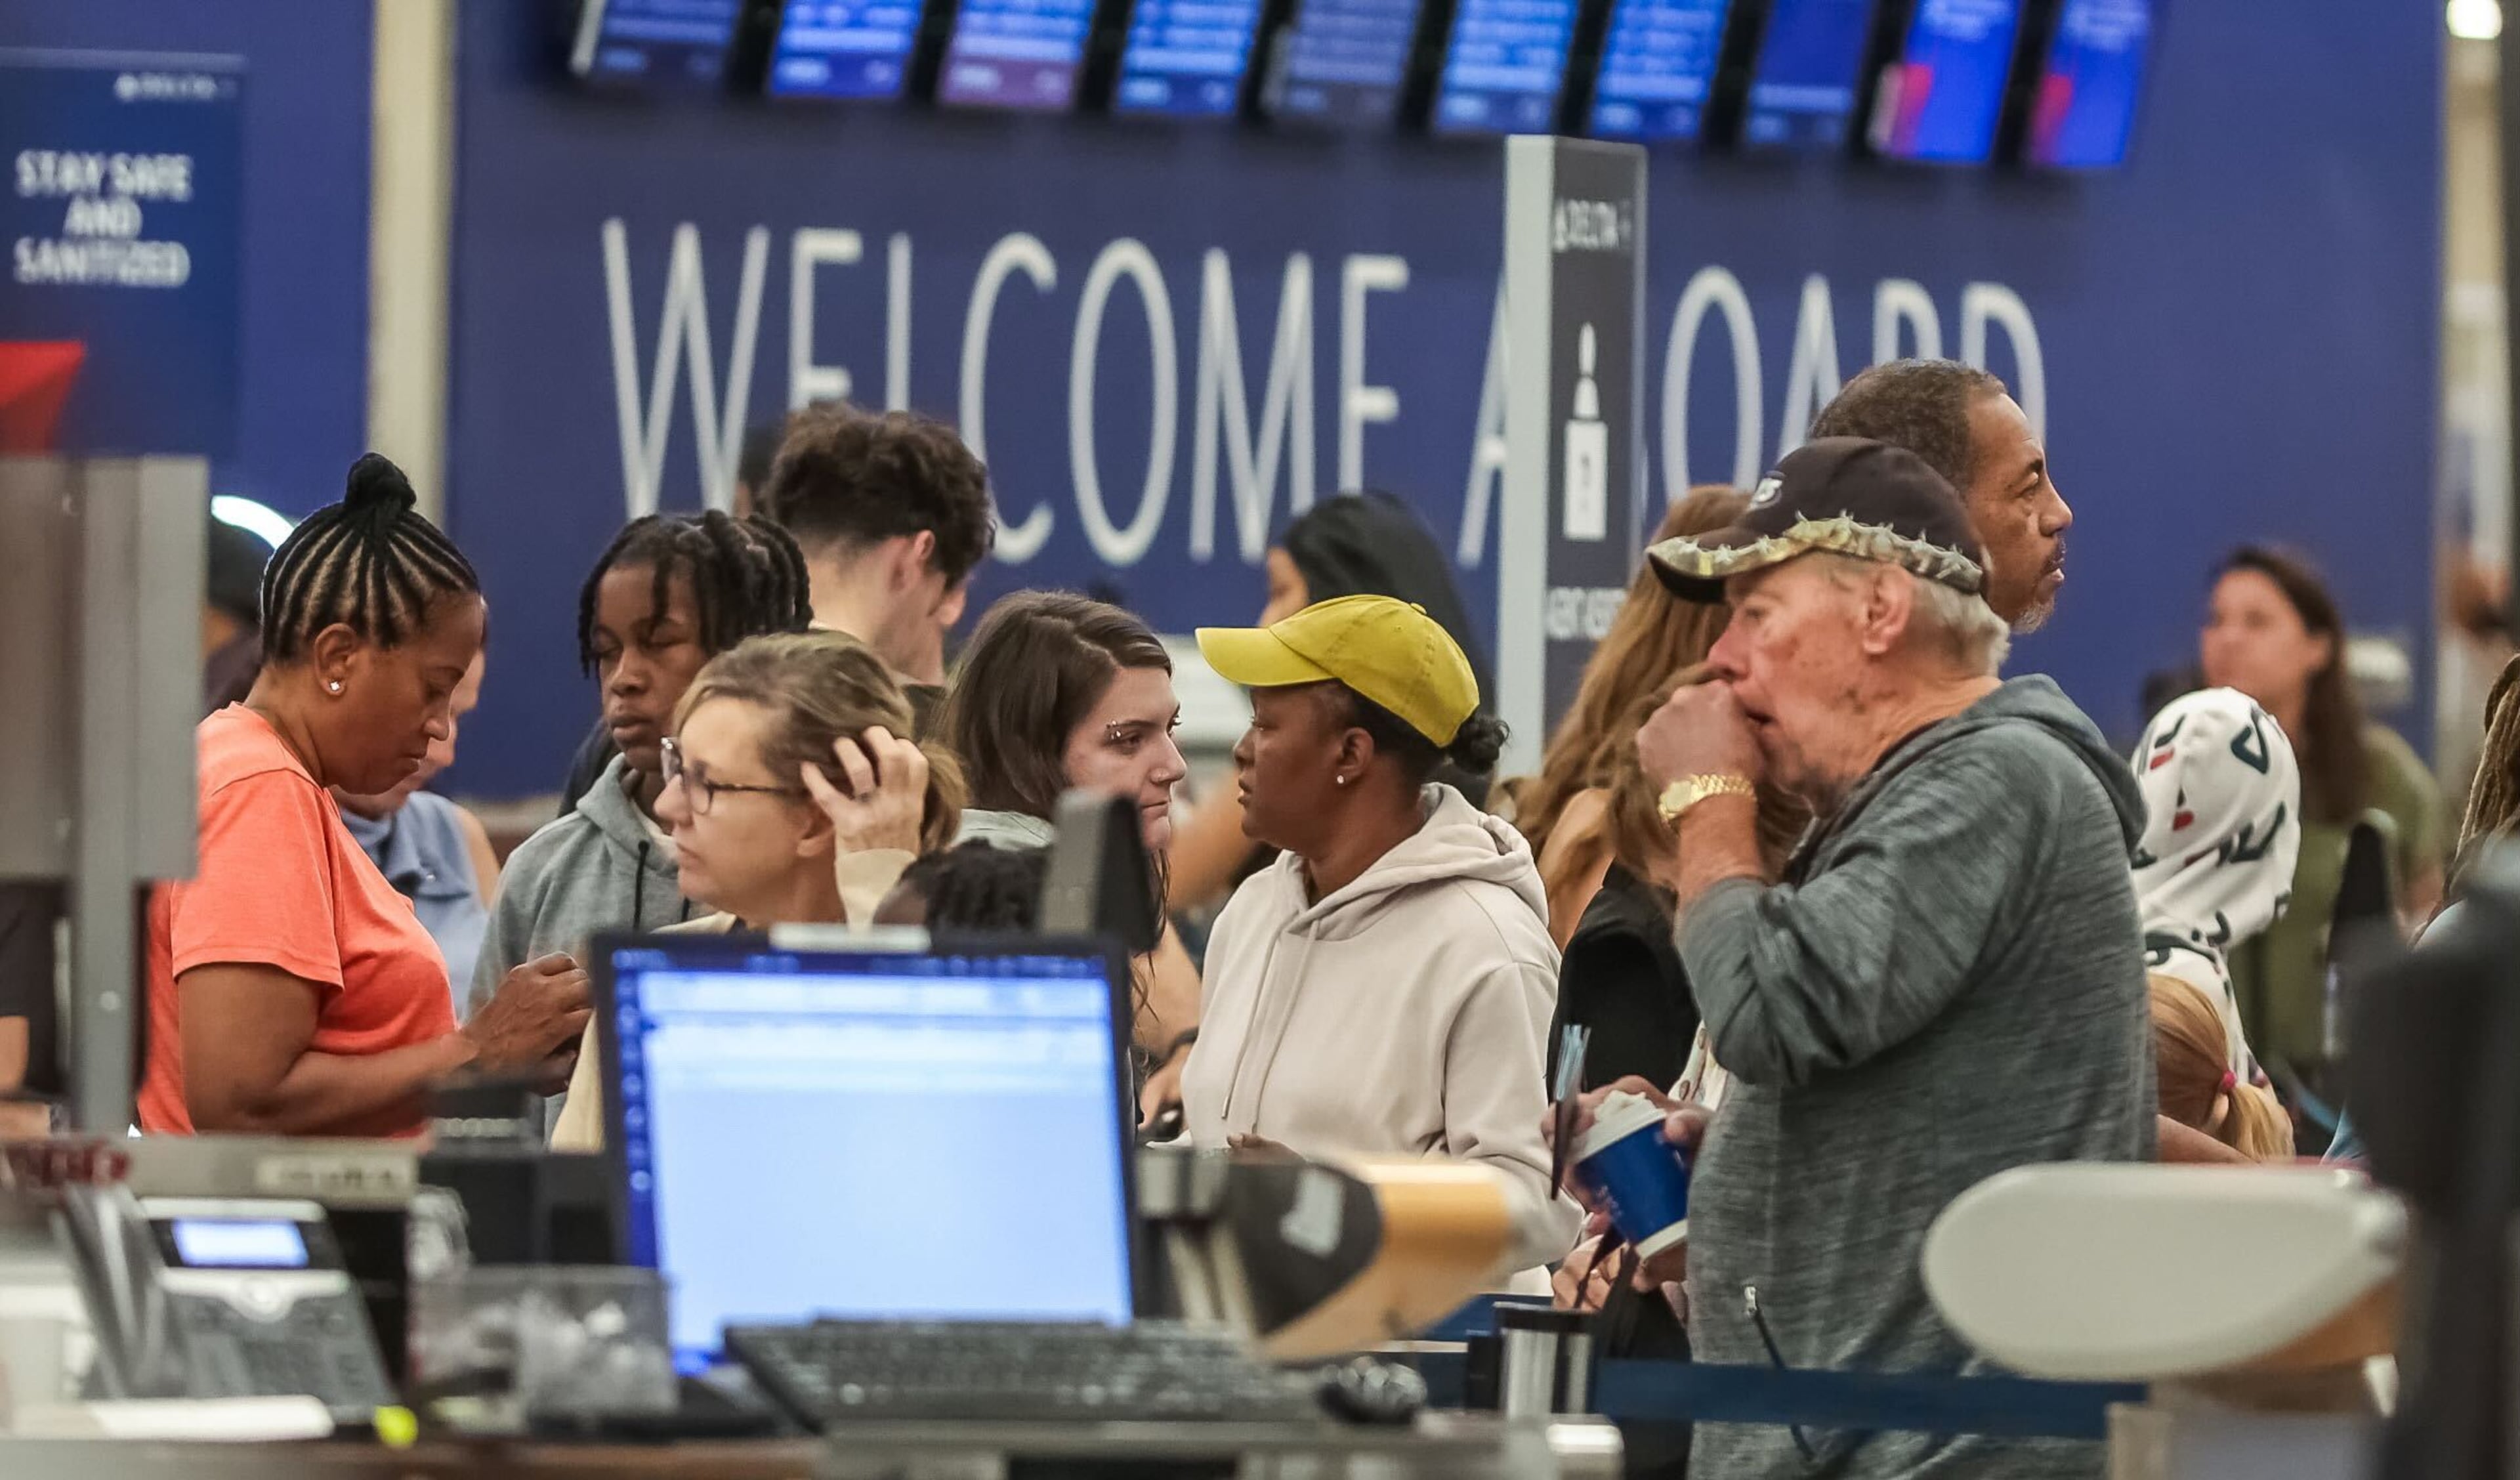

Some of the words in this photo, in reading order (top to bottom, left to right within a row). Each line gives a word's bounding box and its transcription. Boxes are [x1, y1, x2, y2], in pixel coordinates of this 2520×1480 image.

[16, 150, 106, 197] STAY
[110, 152, 194, 201] SAFE
[62, 195, 143, 238] AND
[13, 236, 191, 287] SANITIZED
[602, 217, 1410, 566] WELCOME
[1456, 265, 2048, 570] AOAD
